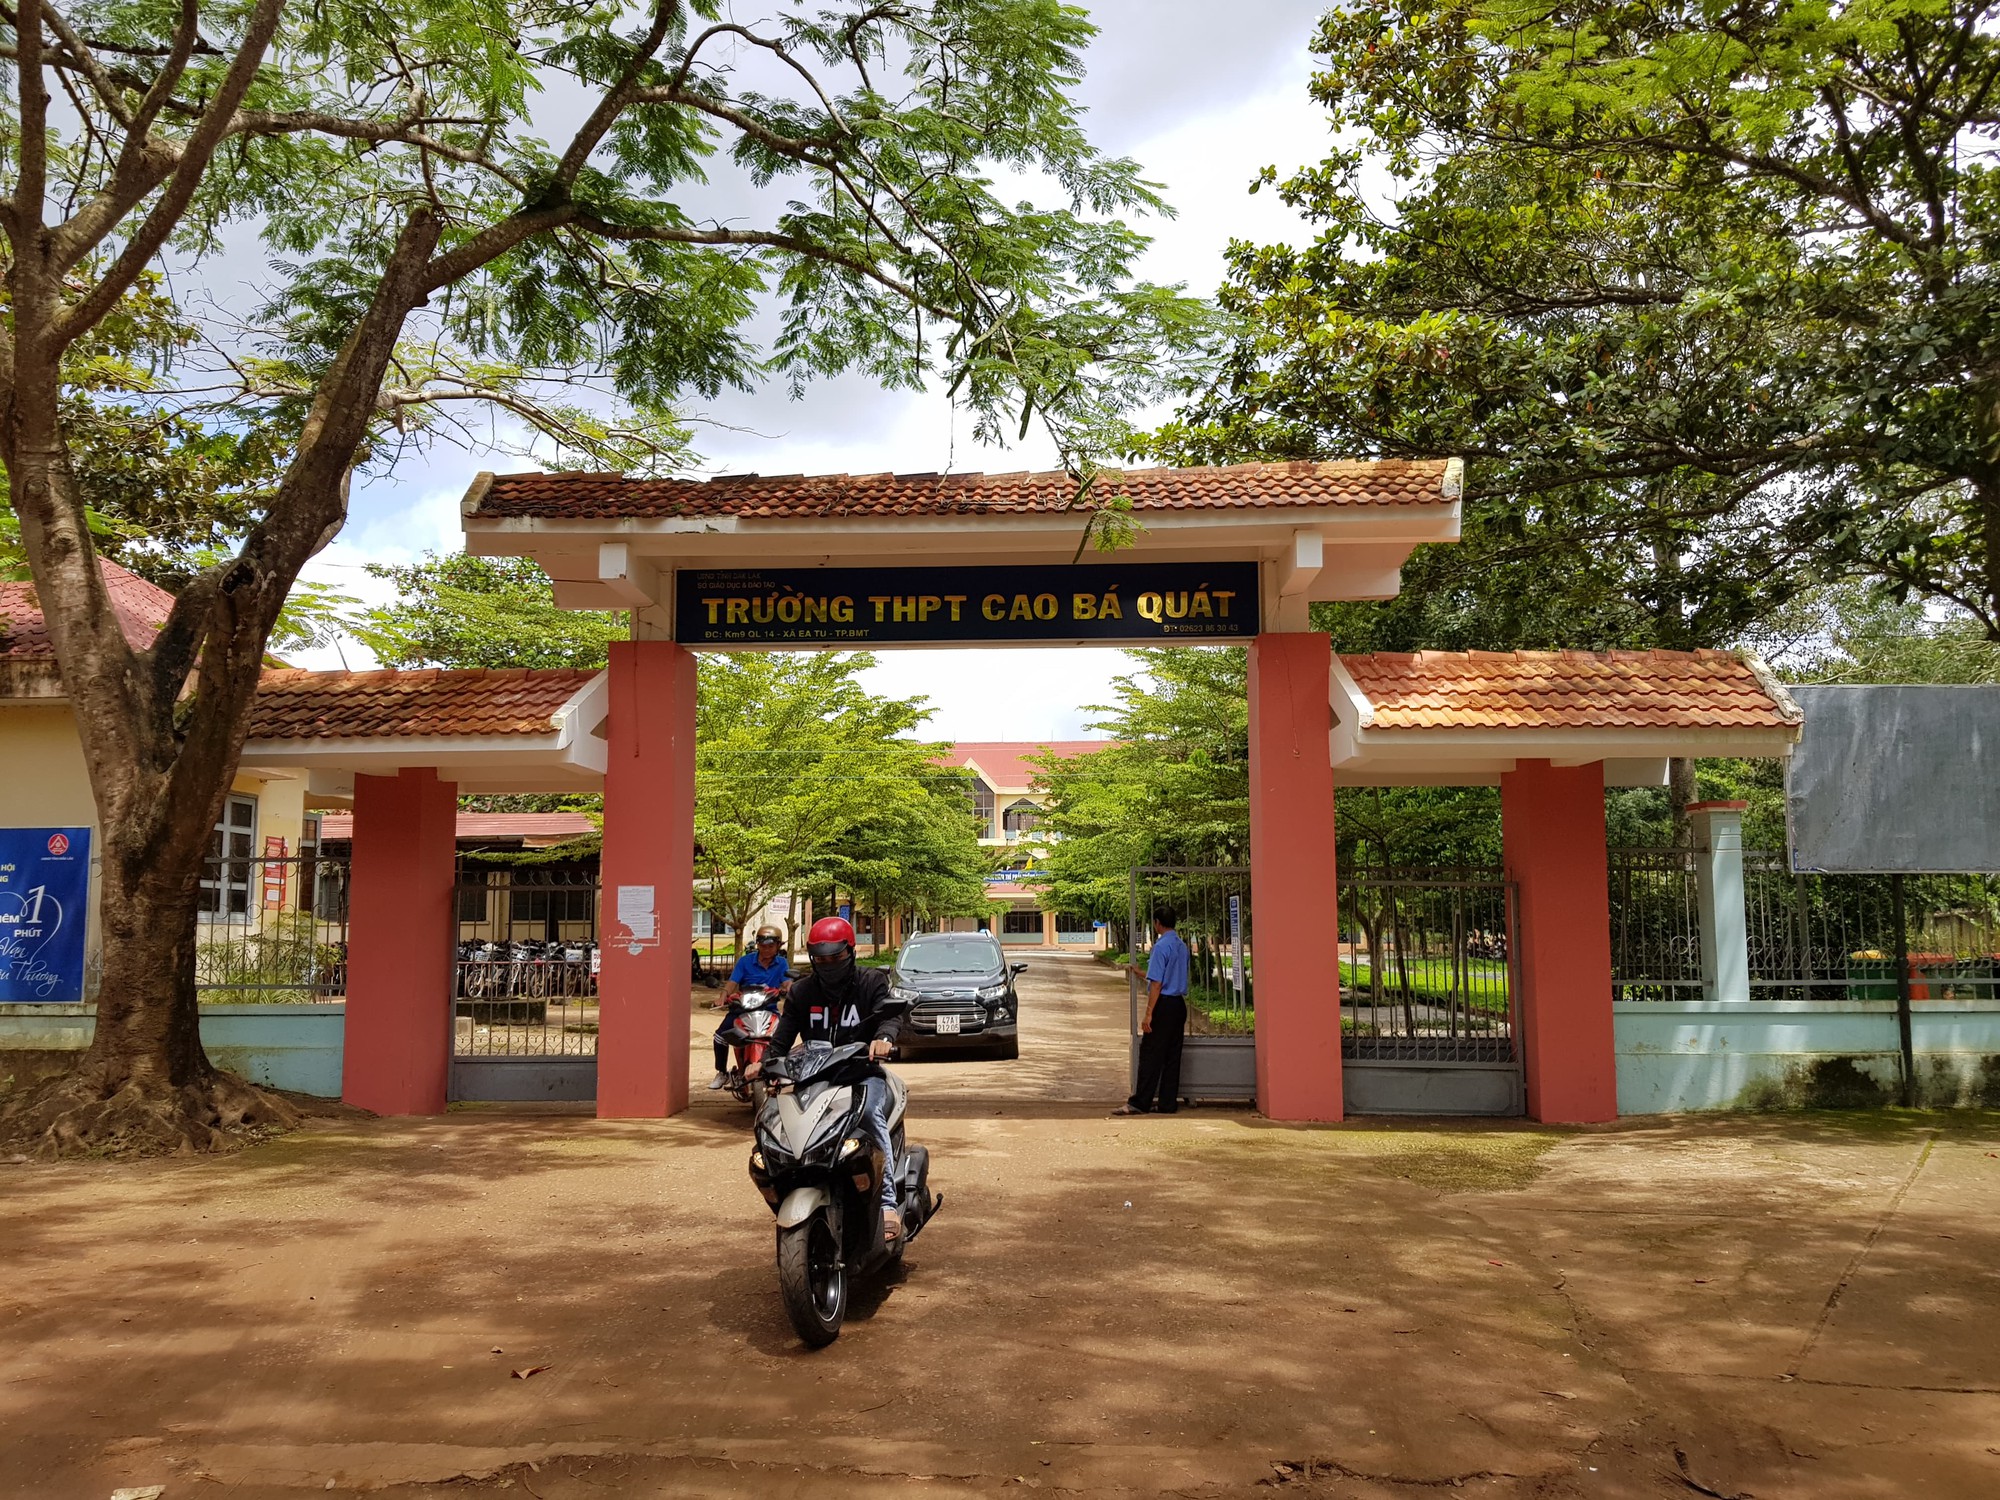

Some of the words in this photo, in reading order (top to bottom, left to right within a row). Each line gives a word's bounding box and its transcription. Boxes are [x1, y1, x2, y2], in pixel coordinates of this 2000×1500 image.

[701, 585, 854, 625] TRƯỜNG
[868, 595, 967, 623] THPT
[981, 593, 1059, 621] CAO
[1072, 584, 1123, 620] BÁ
[1136, 583, 1236, 624] QUÁT
[705, 631, 722, 639] ĐC:
[725, 630, 745, 638] Km9
[748, 630, 761, 638] QL
[783, 628, 796, 638] XÃ
[835, 629, 870, 637] TP.BMT
[1163, 624, 1178, 633] ĐT:
[1179, 625, 1203, 633] 02623
[1217, 624, 1227, 632] 30
[1, 862, 16, 872] HỘI
[26, 885, 46, 924] 1
[14, 927, 43, 938] PHÚT
[809, 1003, 861, 1029] FILA
